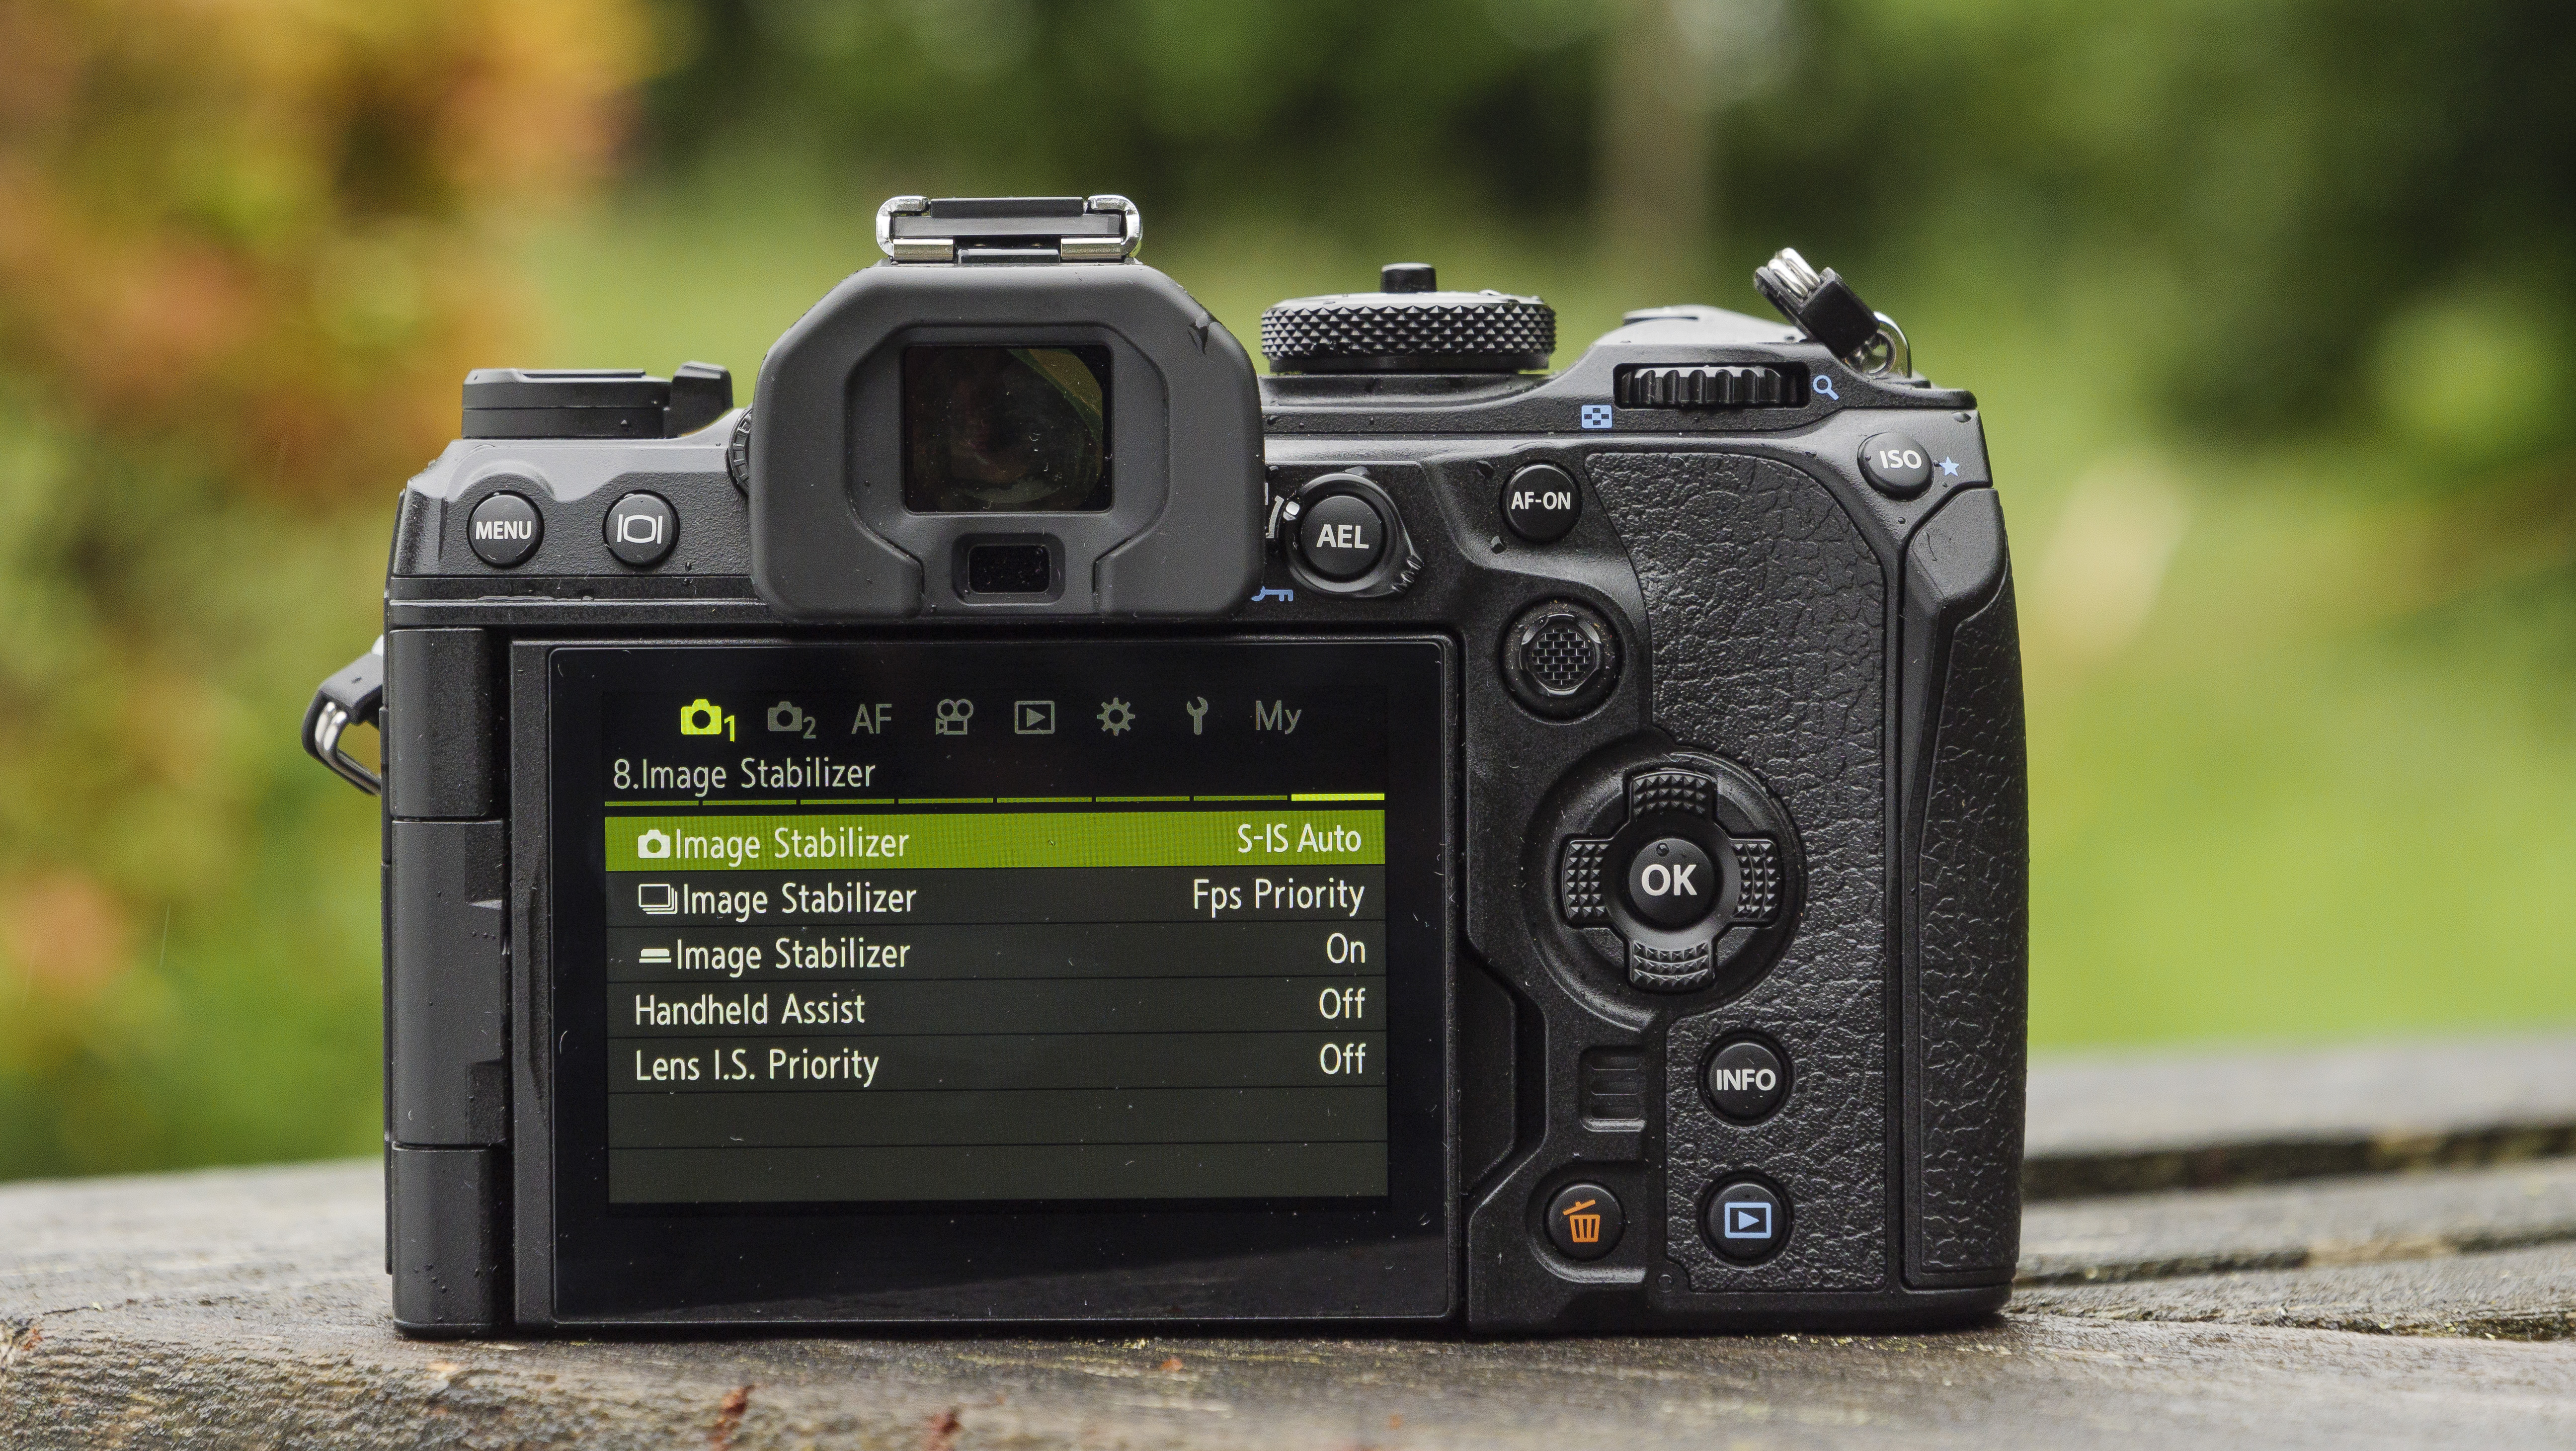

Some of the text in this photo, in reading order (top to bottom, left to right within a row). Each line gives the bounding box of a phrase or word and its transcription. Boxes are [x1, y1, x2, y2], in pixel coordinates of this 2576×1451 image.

[1880, 450, 1922, 470] ISO
[1511, 491, 1571, 510] AF-ON
[475, 520, 532, 540] MENU
[1316, 524, 1369, 549] AEL
[724, 715, 735, 742] 1
[803, 717, 816, 739] 2
[851, 704, 892, 734] AF
[1256, 700, 1301, 734] My
[614, 757, 876, 798] 8.Image Stabilizer
[676, 826, 909, 868] Image Stabilizer
[1238, 823, 1362, 853] S-IS Auto
[1641, 864, 1697, 896] OK
[684, 882, 917, 923] Image Stabilizer
[1194, 878, 1365, 918] Fps Priority
[677, 937, 910, 978] Image Stabilizer
[1327, 933, 1366, 964] On
[636, 992, 865, 1025] Handheld Assist
[1319, 988, 1366, 1019] Off
[636, 1048, 879, 1088] Lens I.S. Priority
[1320, 1043, 1367, 1075] Off
[1716, 1068, 1776, 1091] INFO
